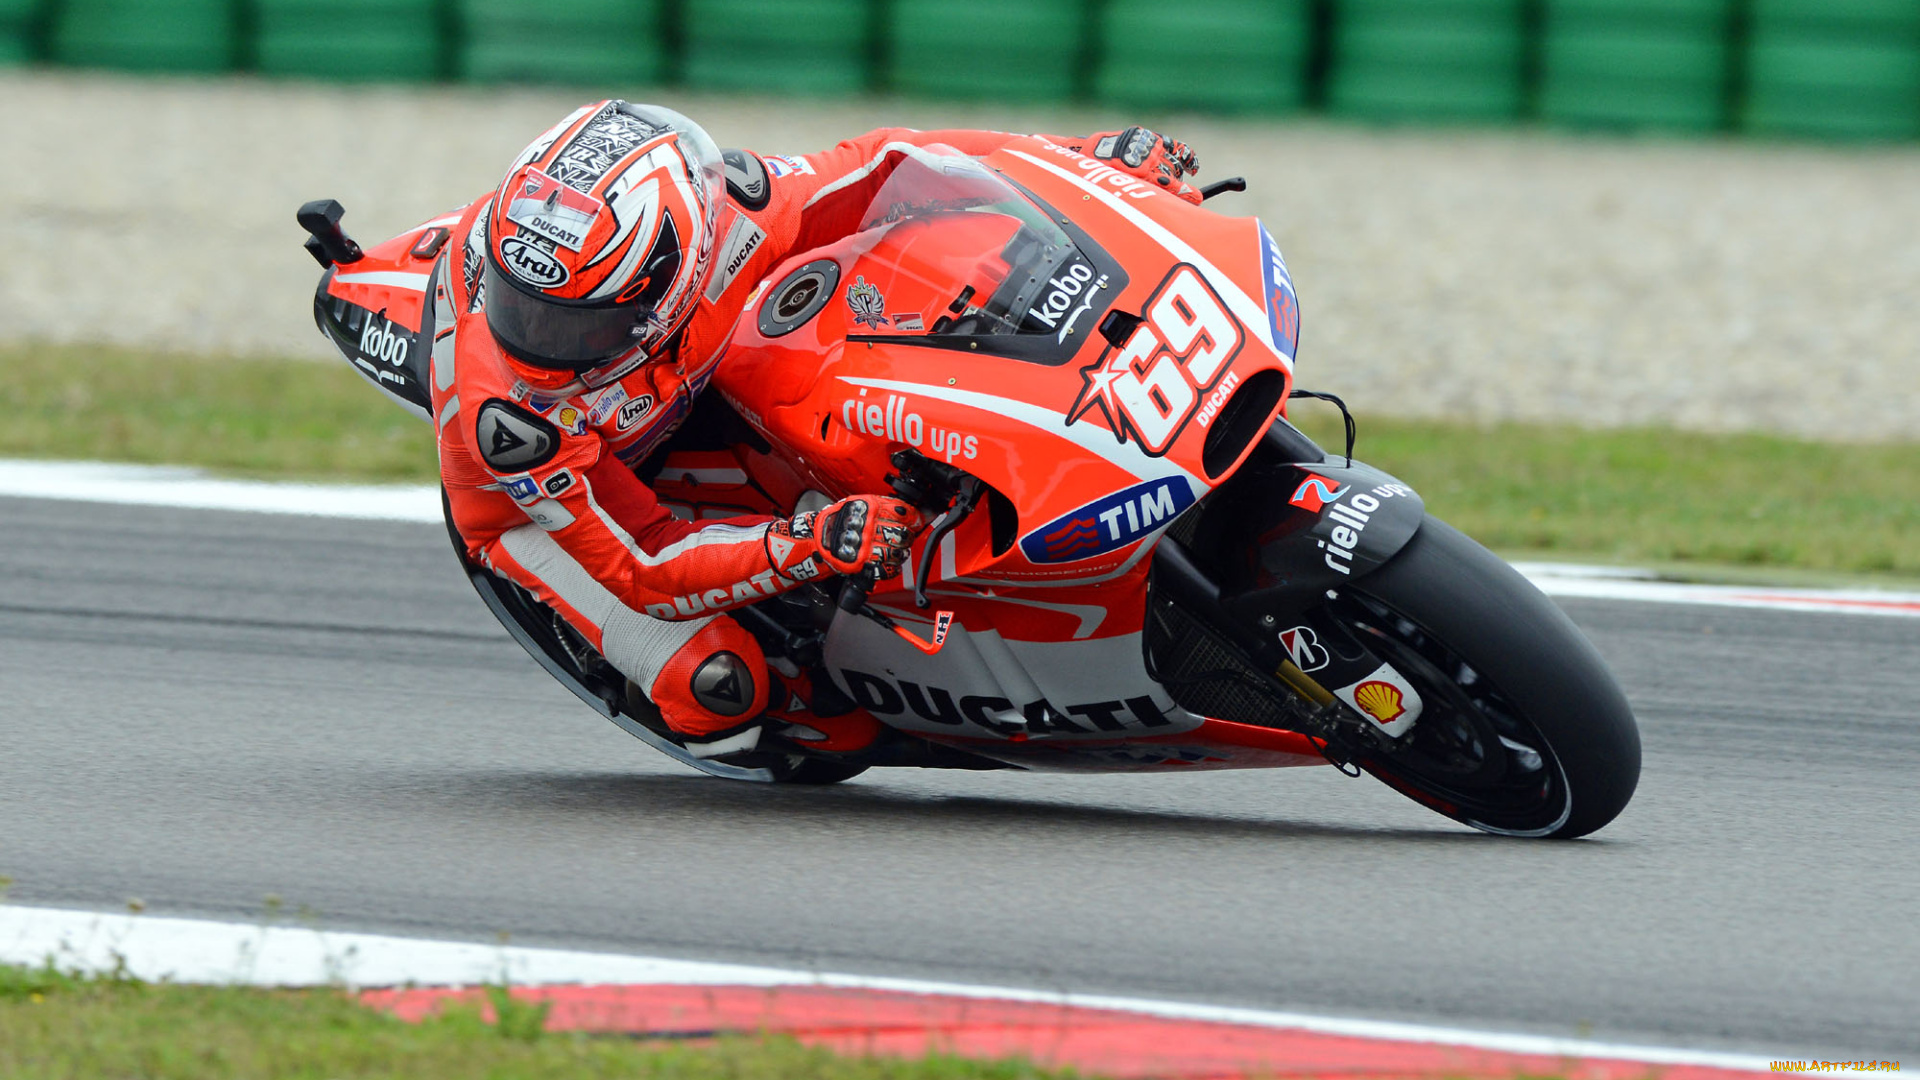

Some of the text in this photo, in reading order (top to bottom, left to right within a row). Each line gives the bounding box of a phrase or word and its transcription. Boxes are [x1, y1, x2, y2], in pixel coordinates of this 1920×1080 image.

[1078, 162, 1156, 199] riello
[531, 217, 580, 245] DUCATI
[727, 231, 761, 276] DUCATI
[503, 245, 558, 279] Arai
[1029, 263, 1093, 328] kobo
[360, 311, 408, 367] kobo
[631, 326, 647, 335] 69
[1108, 266, 1241, 452] 69
[598, 395, 613, 418] riello
[611, 390, 625, 402] ups
[620, 397, 648, 424] Arai
[843, 388, 979, 463] riello ups
[1196, 371, 1240, 428] DUCATI
[1100, 484, 1176, 541] TIM
[1318, 493, 1380, 575] riello
[645, 567, 796, 621] DUCATI
[791, 556, 820, 580] 69
[841, 668, 1171, 735] DUCATI
